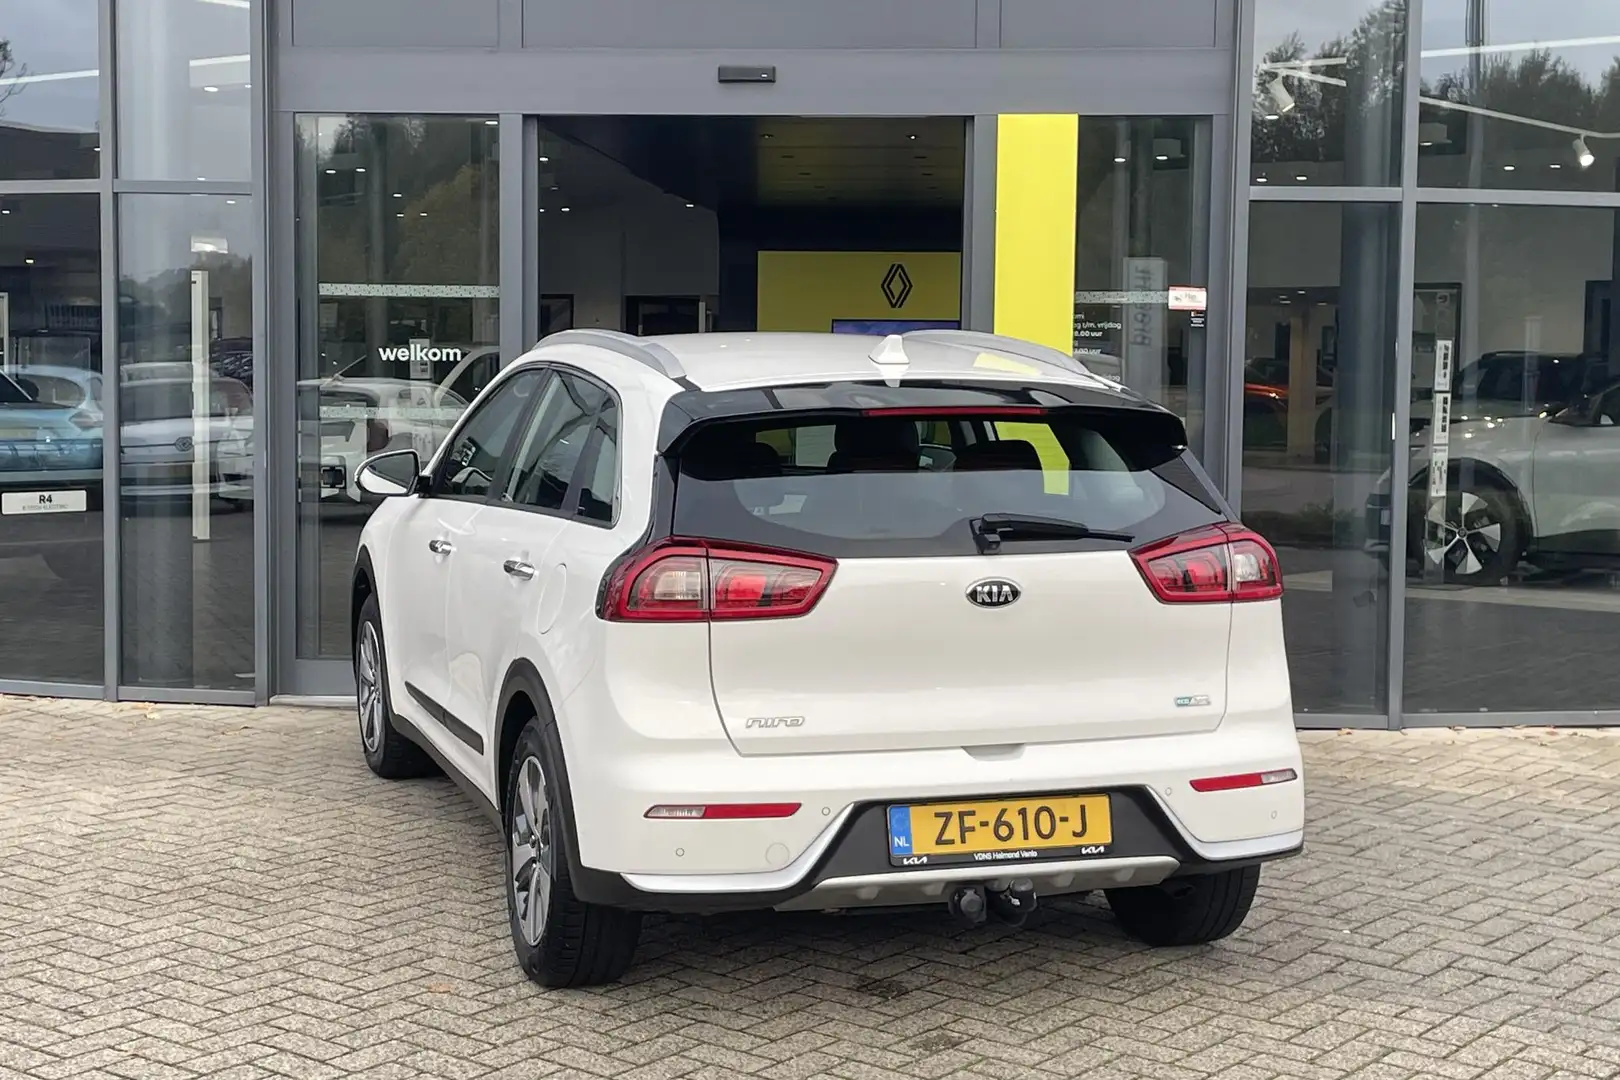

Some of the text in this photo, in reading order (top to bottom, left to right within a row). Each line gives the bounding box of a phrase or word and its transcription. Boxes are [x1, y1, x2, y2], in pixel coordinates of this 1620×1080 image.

[1097, 321, 1122, 330] vrijdag
[378, 343, 462, 362] welkom
[39, 494, 53, 504] R4
[976, 585, 1014, 602] KIA
[934, 804, 1087, 846] ZF-610-J
[894, 836, 910, 847] NL
[993, 850, 1020, 859] Helmond
[1020, 849, 1038, 858] Venlo
